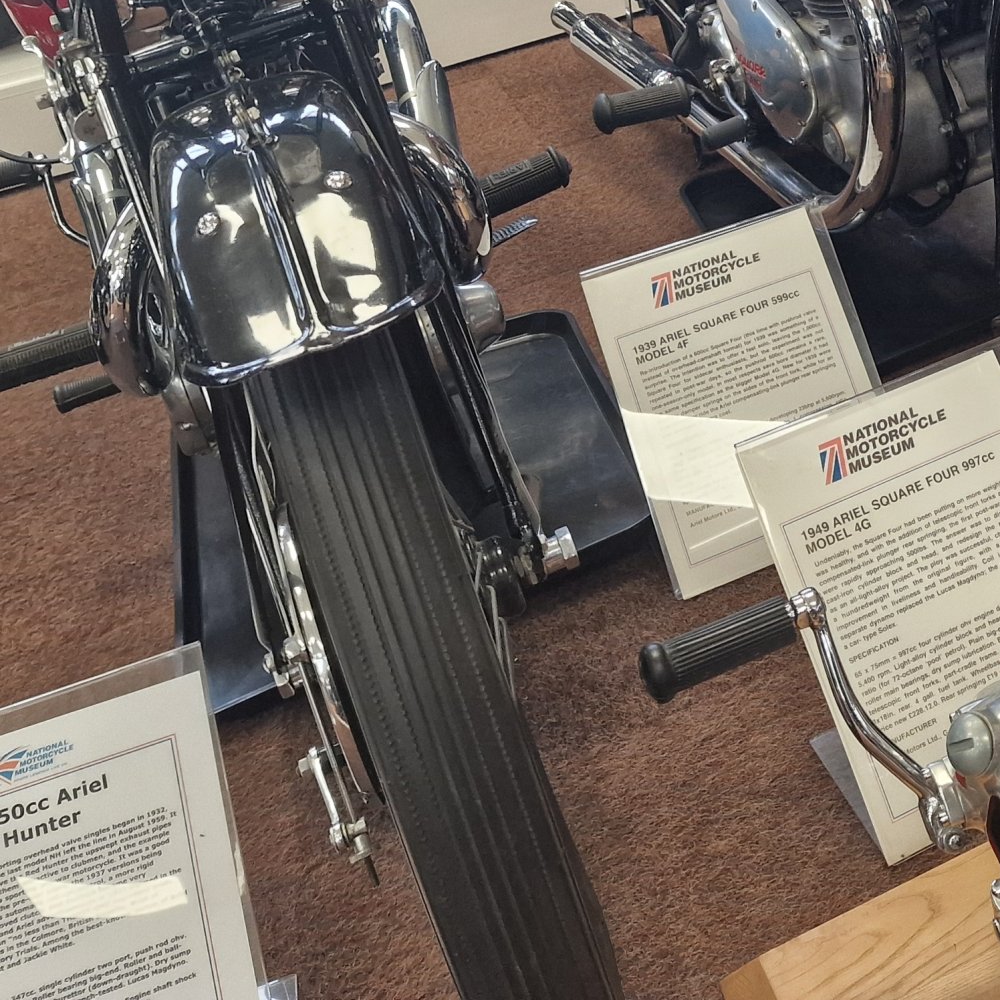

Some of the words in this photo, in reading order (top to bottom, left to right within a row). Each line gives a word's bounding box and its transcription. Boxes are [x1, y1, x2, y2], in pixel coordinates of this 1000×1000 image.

[672, 250, 737, 278] NATIONAL
[674, 252, 760, 290] MOTORCYCLE
[676, 273, 732, 301] MUSEUM
[633, 340, 656, 355] 1939
[660, 328, 691, 346] ARIEL
[693, 311, 738, 332] SQUARE
[740, 300, 769, 317] FOUR
[772, 290, 799, 306] 599cc
[636, 345, 675, 364] MODEL
[677, 339, 689, 351] 4F
[843, 407, 918, 446] NATIONAL
[846, 409, 946, 459] MOTORCYCLE
[848, 437, 915, 474] MUSEUM
[801, 521, 830, 540] 1949
[834, 505, 870, 528] ARIEL
[871, 480, 924, 510] SQUARE
[926, 465, 960, 487] FOUR
[962, 452, 995, 471] 997cc
[806, 530, 852, 554] MODEL
[855, 519, 871, 532] 4G
[815, 568, 828, 577] was
[856, 549, 869, 558] and
[870, 542, 884, 552] with
[897, 526, 923, 540] addition
[932, 508, 963, 525] telescopic
[963, 500, 979, 510] front
[979, 494, 996, 503] forks
[851, 542, 863, 550] the
[863, 532, 887, 545] Square
[887, 525, 902, 534] Four
[903, 518, 916, 527] had
[916, 512, 932, 521] been
[933, 502, 956, 515] putting
[965, 490, 981, 500] more
[848, 636, 899, 663] SPECIFICATION
[865, 695, 882, 706] roller
[883, 686, 899, 697] main
[930, 666, 942, 674] dry
[942, 657, 962, 668] sump
[893, 716, 907, 725] new
[940, 692, 956, 702] Rear
[956, 677, 987, 695] springing
[986, 670, 998, 680] £19
[15, 759, 53, 776] MUSEUM
[20, 744, 73, 767] MOTORCYCLE
[26, 740, 68, 758] NATIONAL
[0, 798, 49, 825] 50cc
[57, 774, 108, 805] Ariel
[3, 811, 81, 847] Hunter
[6, 864, 21, 874] last
[23, 855, 47, 869] model
[48, 850, 61, 859] NH
[62, 845, 76, 854] left
[77, 841, 91, 849] the
[92, 835, 107, 844] line
[117, 820, 144, 835] August
[169, 809, 176, 817] It
[23, 842, 59, 860] overhead
[61, 836, 81, 847] valve
[83, 826, 110, 839] singles
[111, 817, 135, 829] began
[107, 845, 122, 856] and
[123, 842, 136, 850] the
[138, 830, 169, 845] example
[24, 866, 40, 876] Red
[41, 857, 69, 870] Hunter
[70, 852, 83, 860] the
[85, 838, 118, 855] upswept
[119, 827, 150, 843] exhaust
[151, 821, 171, 834] pipes
[118, 852, 126, 860] It
[127, 848, 143, 857] was
[150, 836, 170, 850] good
[6, 958, 21, 969] and
[22, 950, 48, 962] Jackie
[38, 980, 62, 992] single
[63, 967, 96, 982] cylinder
[96, 960, 112, 970] two
[134, 944, 153, 957] push
[155, 938, 168, 948] rod
[154, 957, 169, 966] Dry
[170, 948, 191, 960] sump
[126, 973, 149, 984] Lucas
